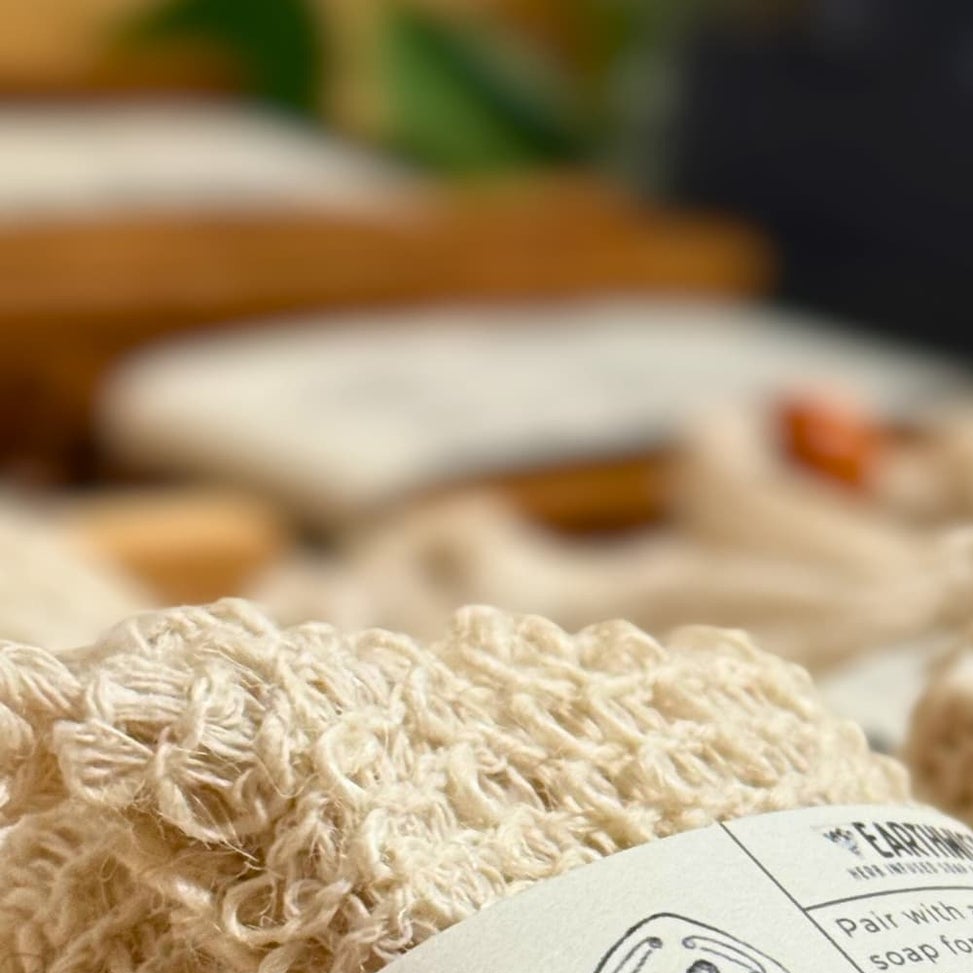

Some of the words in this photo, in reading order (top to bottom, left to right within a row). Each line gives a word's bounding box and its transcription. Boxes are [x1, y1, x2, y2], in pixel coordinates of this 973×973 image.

[836, 911, 900, 938] Pair
[900, 901, 966, 927] with
[869, 942, 941, 972] soap
